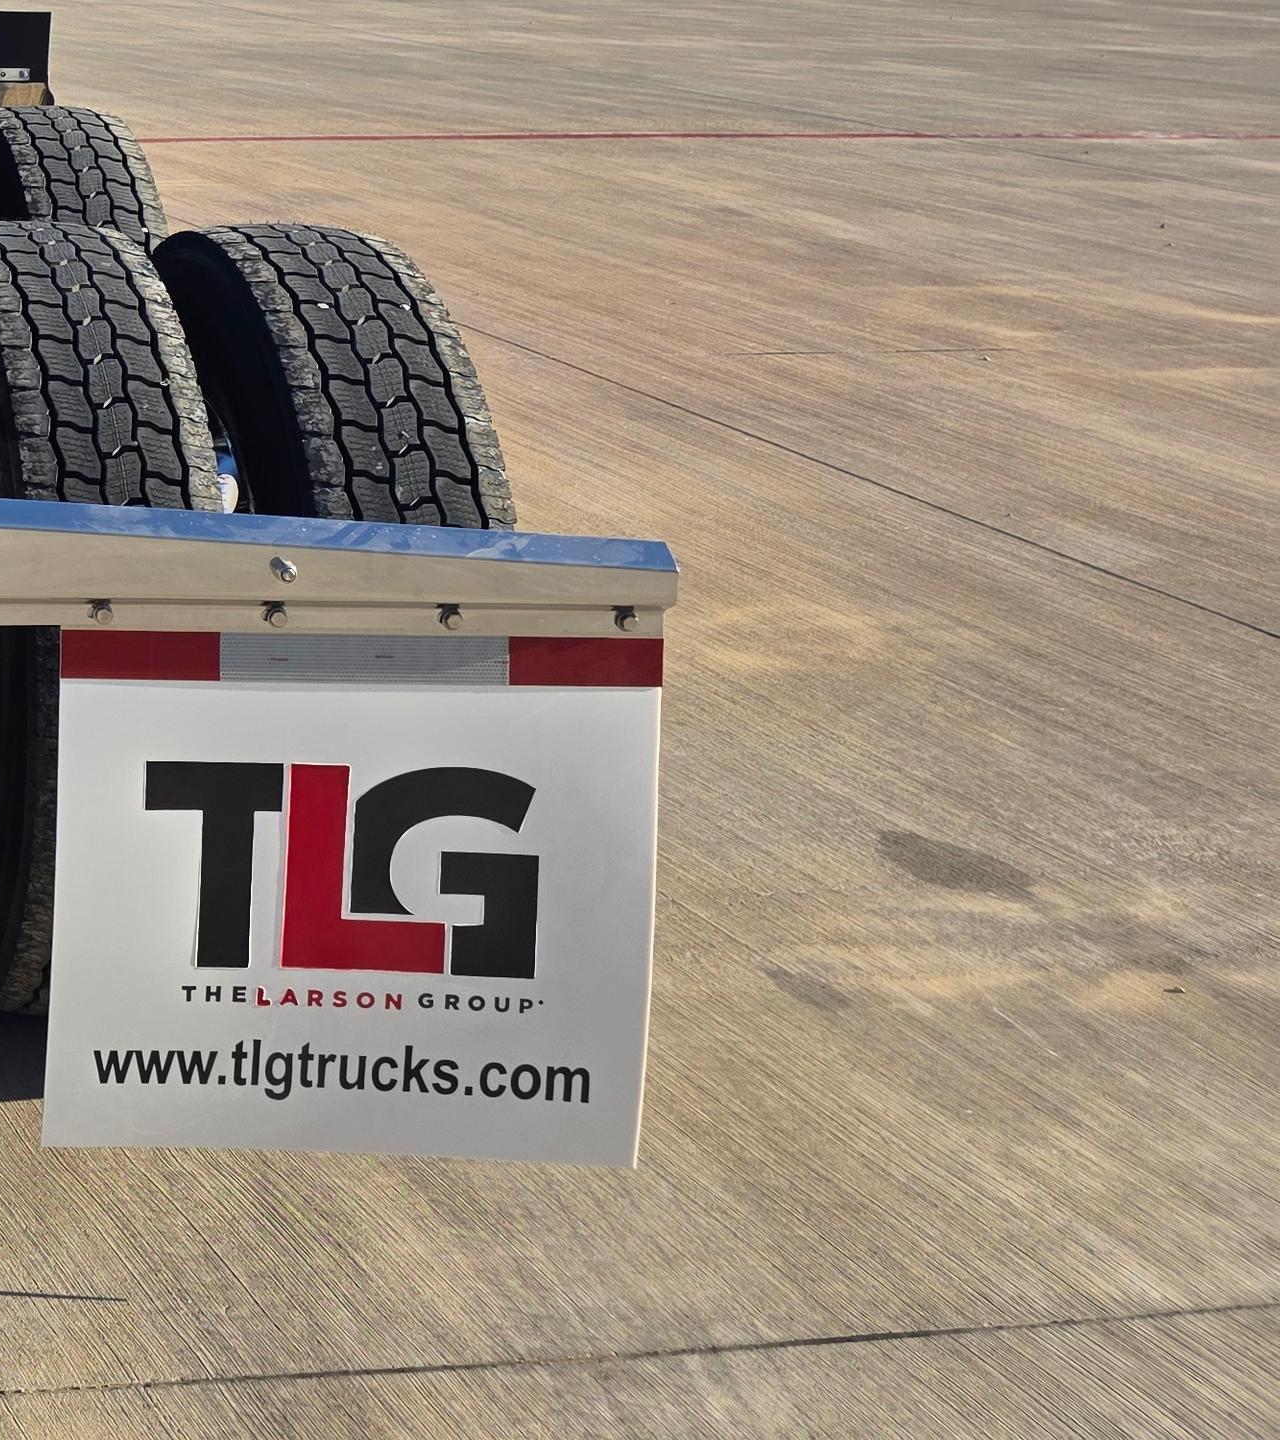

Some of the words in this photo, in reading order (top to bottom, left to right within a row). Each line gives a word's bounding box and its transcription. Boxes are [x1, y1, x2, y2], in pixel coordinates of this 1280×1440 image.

[144, 760, 541, 980] TLG
[417, 992, 534, 1015] GROUP
[92, 1038, 591, 1104] www.tlgtrucks.com
